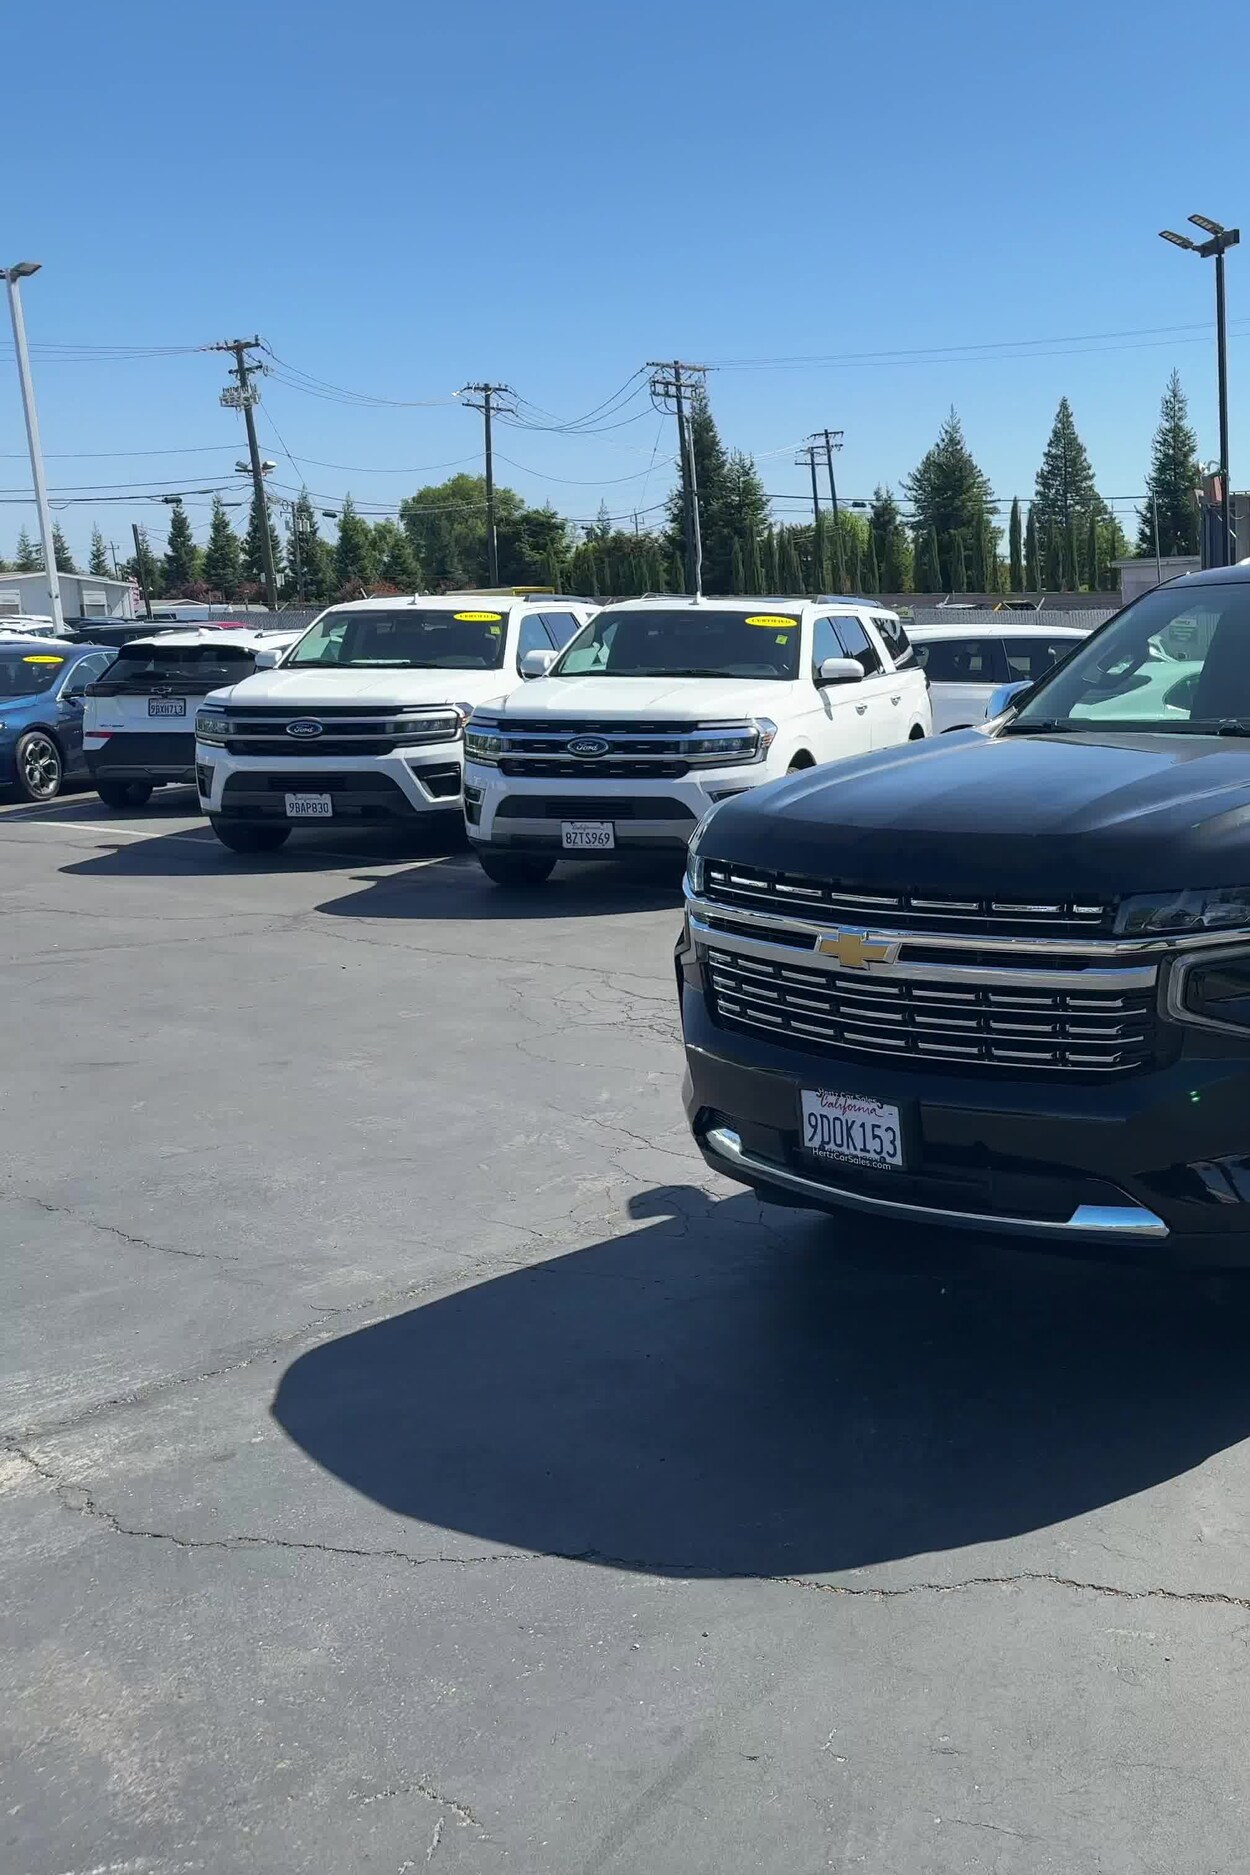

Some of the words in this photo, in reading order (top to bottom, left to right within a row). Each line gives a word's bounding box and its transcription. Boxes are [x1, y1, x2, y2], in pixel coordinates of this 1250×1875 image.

[289, 802, 329, 814] 9BAP830
[565, 832, 610, 845] 8ZTS969
[820, 1095, 884, 1117] California
[812, 1148, 891, 1170] HertzCarSales.com
